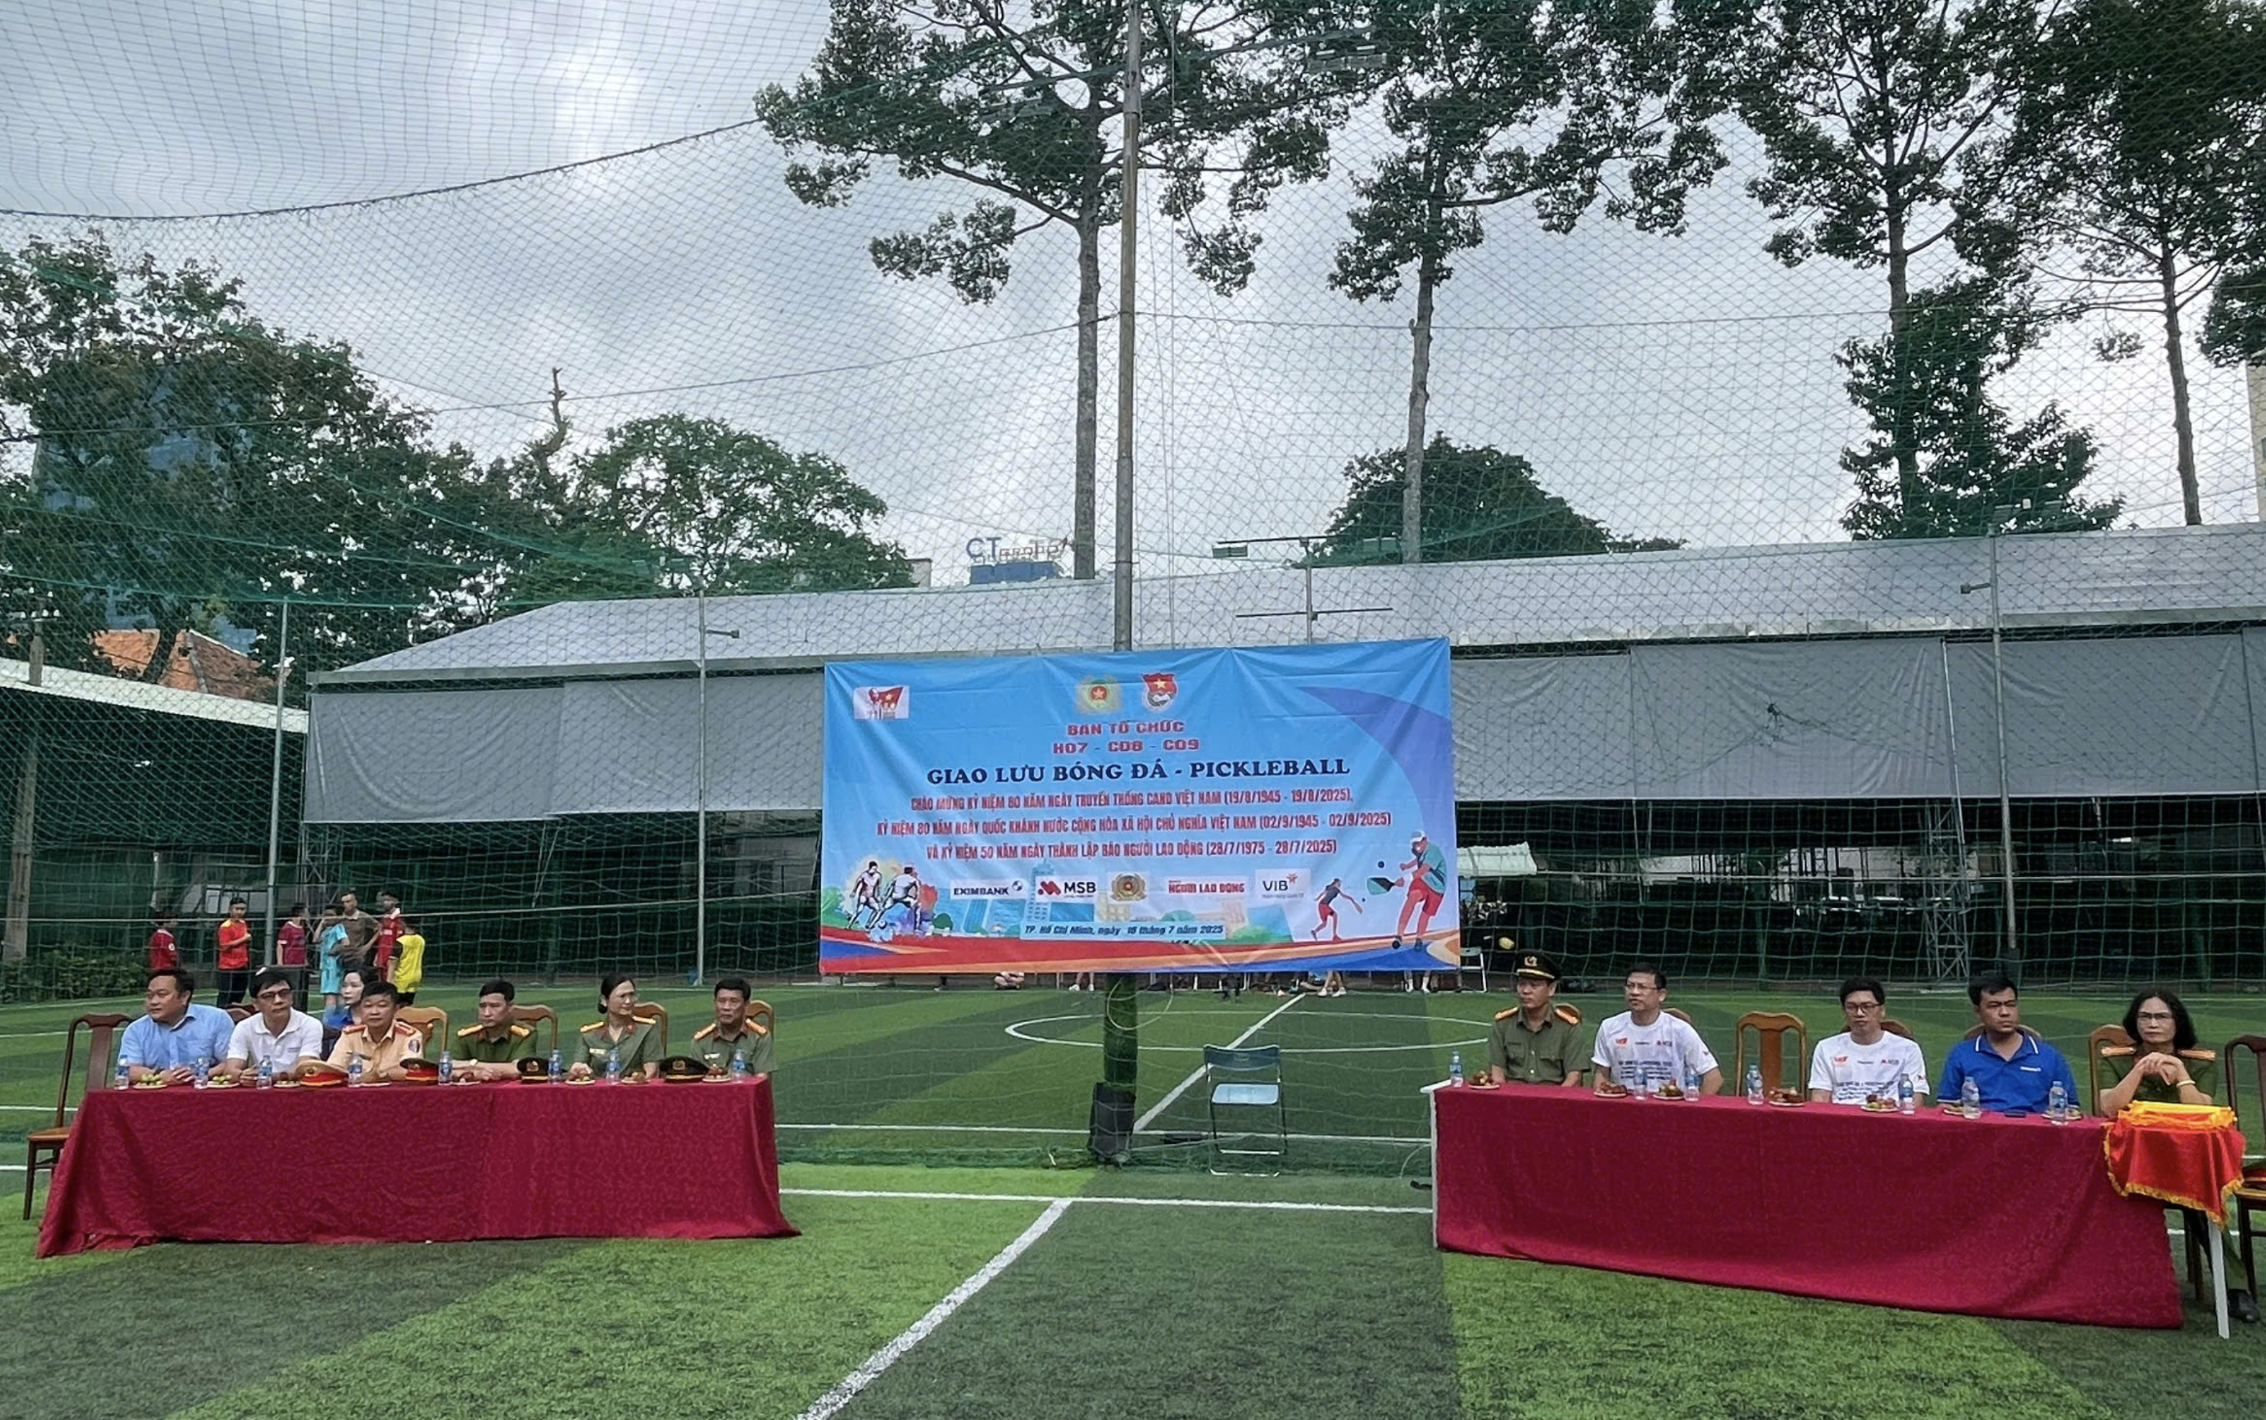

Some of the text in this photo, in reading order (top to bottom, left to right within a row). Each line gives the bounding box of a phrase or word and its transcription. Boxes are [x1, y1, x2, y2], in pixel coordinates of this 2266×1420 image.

[1067, 723, 1101, 736] BAN
[1136, 720, 1185, 734] CHỨC
[927, 768, 988, 785] GIAO
[996, 764, 1045, 783] LƯU
[1053, 761, 1123, 782] BÓNG
[1131, 758, 1168, 778] ĐÁ
[1190, 759, 1350, 778] PICKLEBALL
[1023, 791, 1045, 808] NĂM
[1048, 790, 1072, 808] NGÀY
[1175, 788, 1197, 807] VIỆT
[1200, 790, 1221, 805] NAM
[917, 821, 930, 835] 80
[982, 816, 1007, 835] QUỐC
[1009, 817, 1040, 834] KHÁNH
[1043, 815, 1069, 833] NƯỚC
[1071, 815, 1096, 835] CỘNG
[1121, 814, 1134, 831] XÃ
[1137, 814, 1153, 833] HỘI
[1156, 812, 1175, 830] CHỦ
[1178, 813, 1207, 830] NGHĨA
[1210, 812, 1230, 832] VIỆT
[1233, 815, 1257, 830] NAM
[1259, 813, 1319, 830] (02/9/1945
[1329, 812, 1391, 828] 02/9/2025)
[980, 845, 994, 859] 50
[996, 842, 1018, 859] NĂM
[1021, 841, 1045, 859] NGÀY
[1048, 841, 1079, 858] THÀNH
[1081, 841, 1100, 860] LẬP
[1102, 841, 1120, 857] BÁO
[1124, 839, 1153, 857] NGƯỜI
[1156, 842, 1174, 856] LAO
[1177, 838, 1203, 858] ĐỘNG
[1206, 840, 1265, 856] (28/7/1975
[1275, 838, 1337, 855] 28/7/2025)
[953, 887, 1009, 896] EXIMBANK
[1064, 881, 1096, 894] MSB
[1200, 883, 1217, 894] LAO
[1262, 880, 1289, 892] VIB
[1168, 925, 1175, 934] 7
[1199, 924, 1224, 934] 2025
